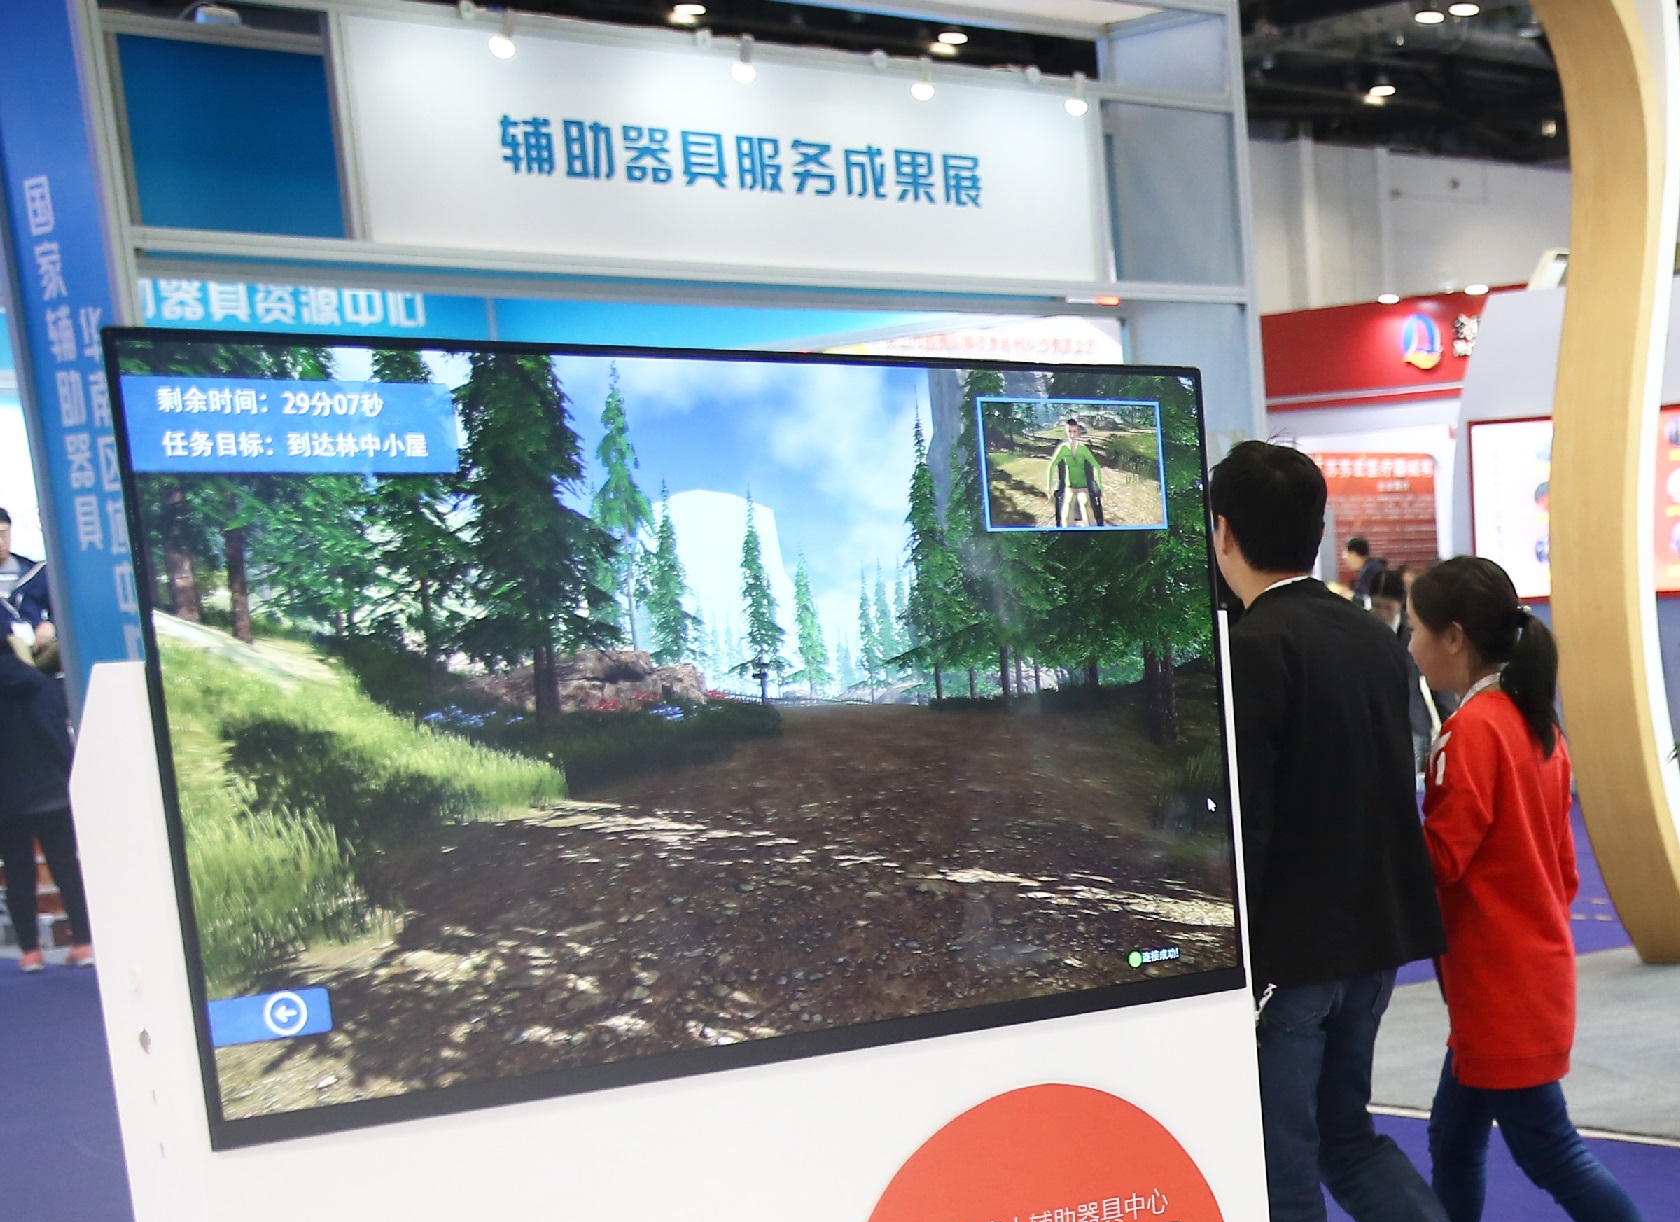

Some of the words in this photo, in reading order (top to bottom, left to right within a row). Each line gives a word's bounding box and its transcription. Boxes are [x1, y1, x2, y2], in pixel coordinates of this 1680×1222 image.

[499, 114, 984, 208] 辅助器具服务成果展
[140, 278, 426, 328] 器具资源中心
[24, 176, 103, 552] 国家辅助器具
